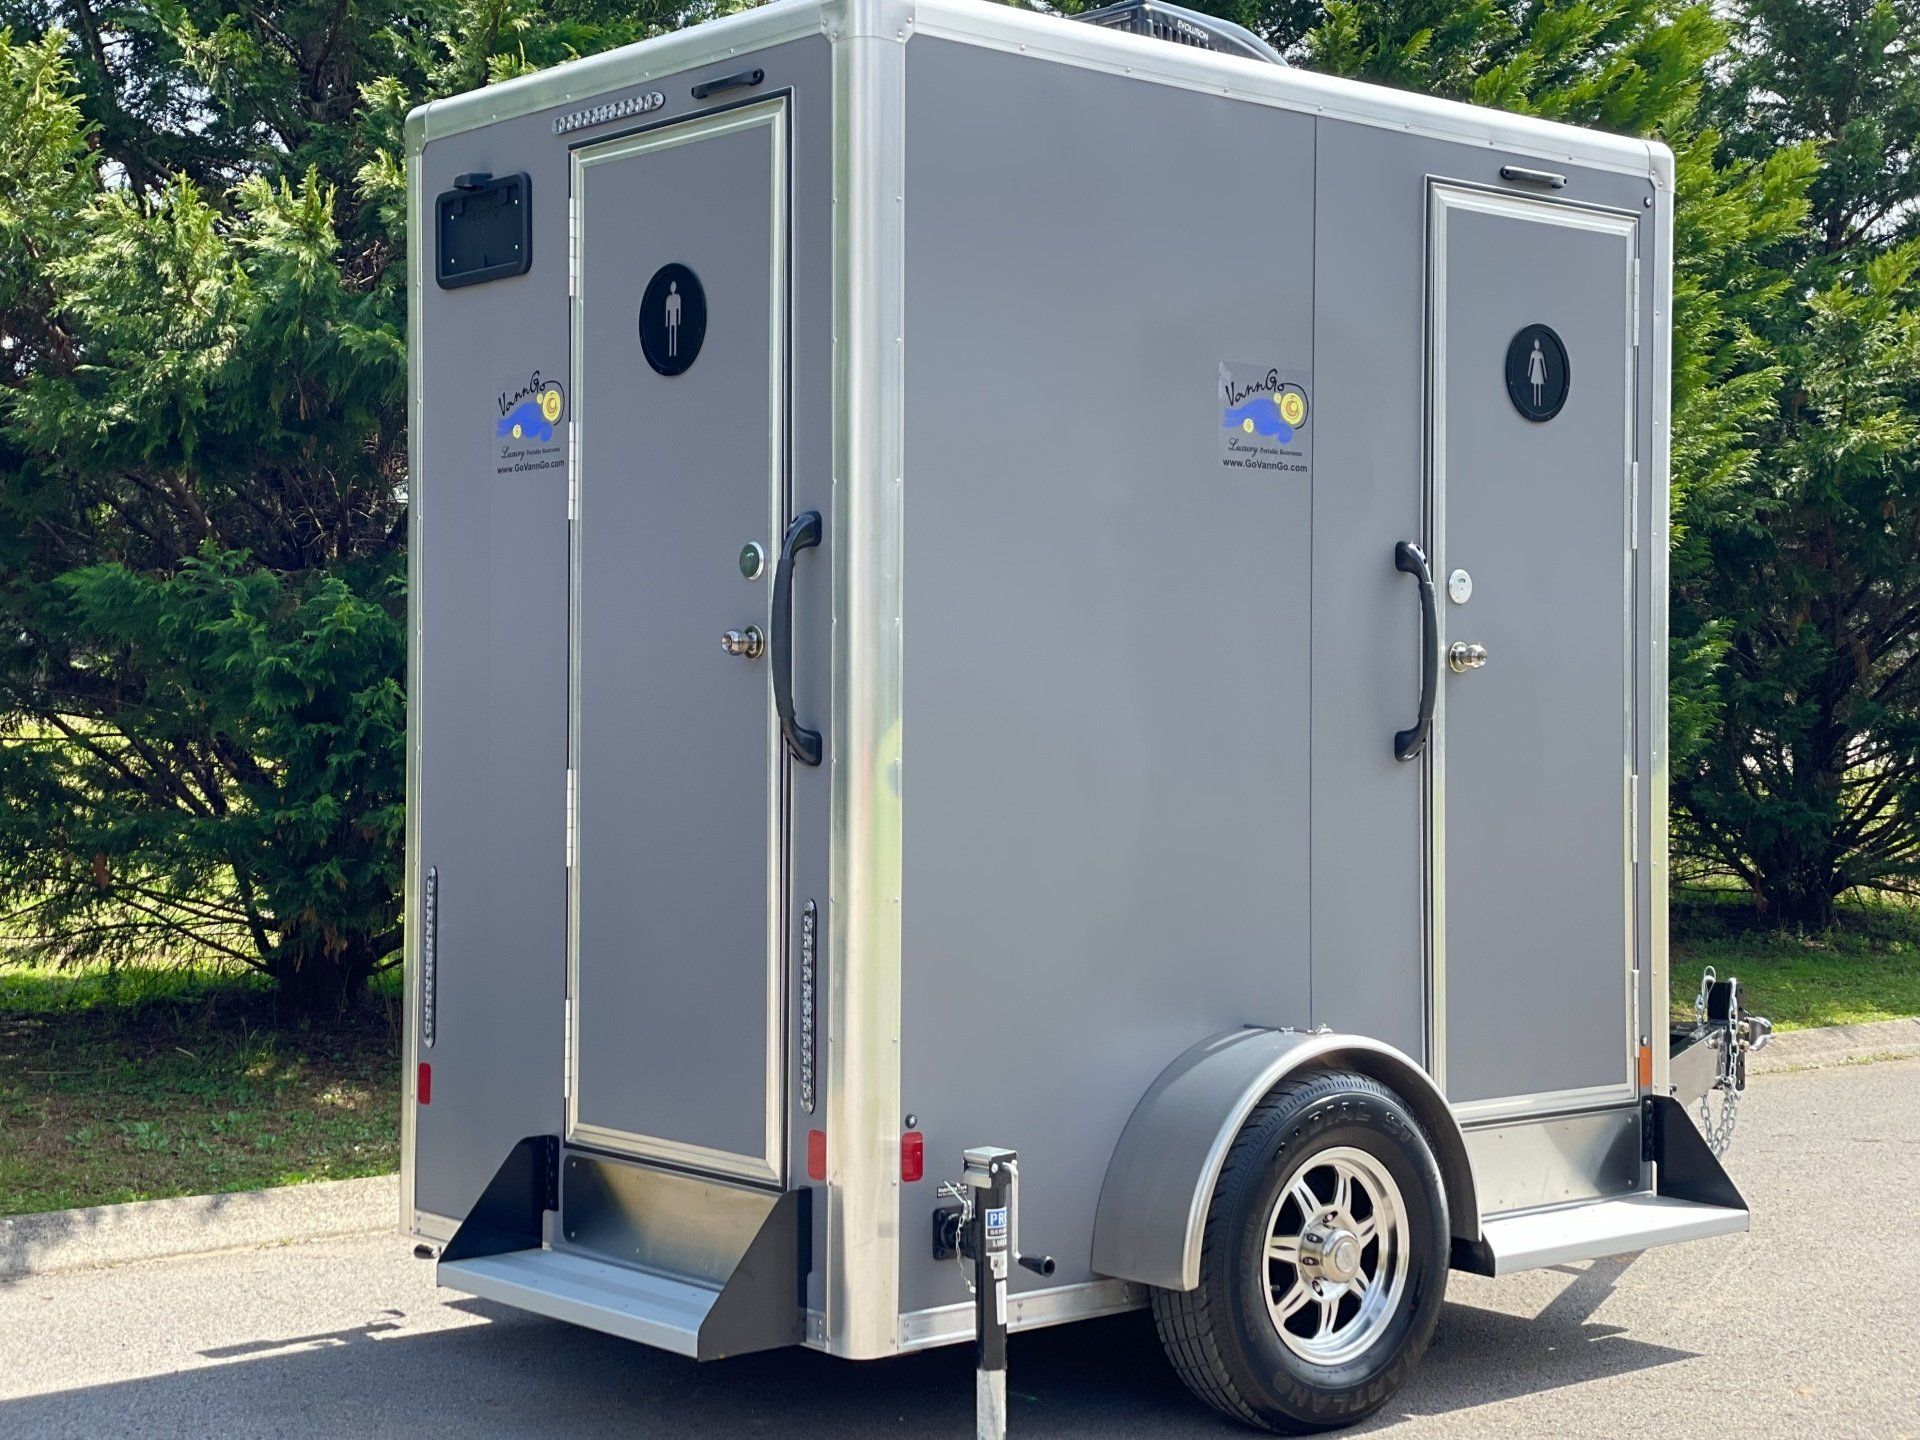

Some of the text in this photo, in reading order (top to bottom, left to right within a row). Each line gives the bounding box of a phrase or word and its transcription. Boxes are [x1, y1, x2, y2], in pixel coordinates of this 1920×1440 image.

[1177, 19, 1209, 41] EVOLUTION
[498, 370, 555, 418] VannGo
[1225, 368, 1297, 417] VannGo
[501, 445, 525, 461] Luxury
[1228, 437, 1258, 457] Luxury
[497, 460, 565, 474] www.GoVannGo.com
[1223, 459, 1308, 473] www.GoVannGo.com
